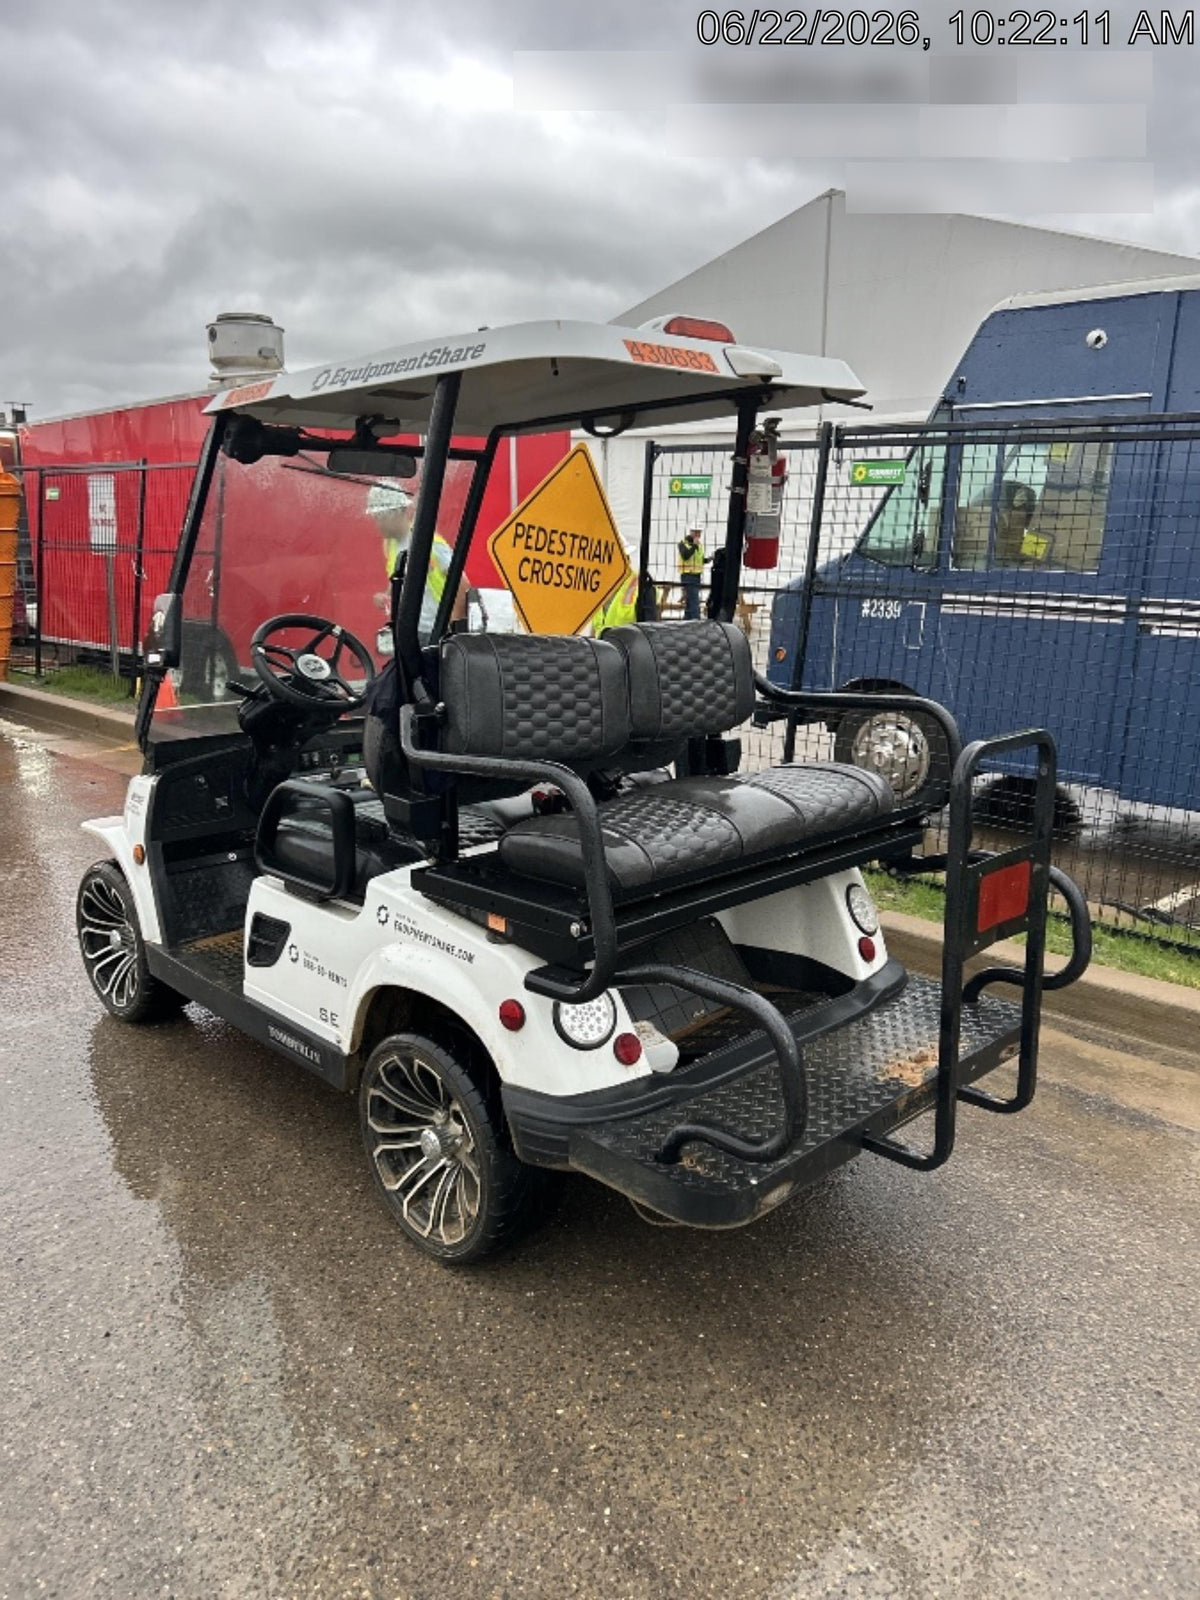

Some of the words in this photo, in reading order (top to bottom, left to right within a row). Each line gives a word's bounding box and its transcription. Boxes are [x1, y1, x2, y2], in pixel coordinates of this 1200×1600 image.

[328, 342, 486, 387] EquipmentShare
[512, 522, 615, 565] PEDESTRIAN
[518, 557, 602, 593] CROSSING
